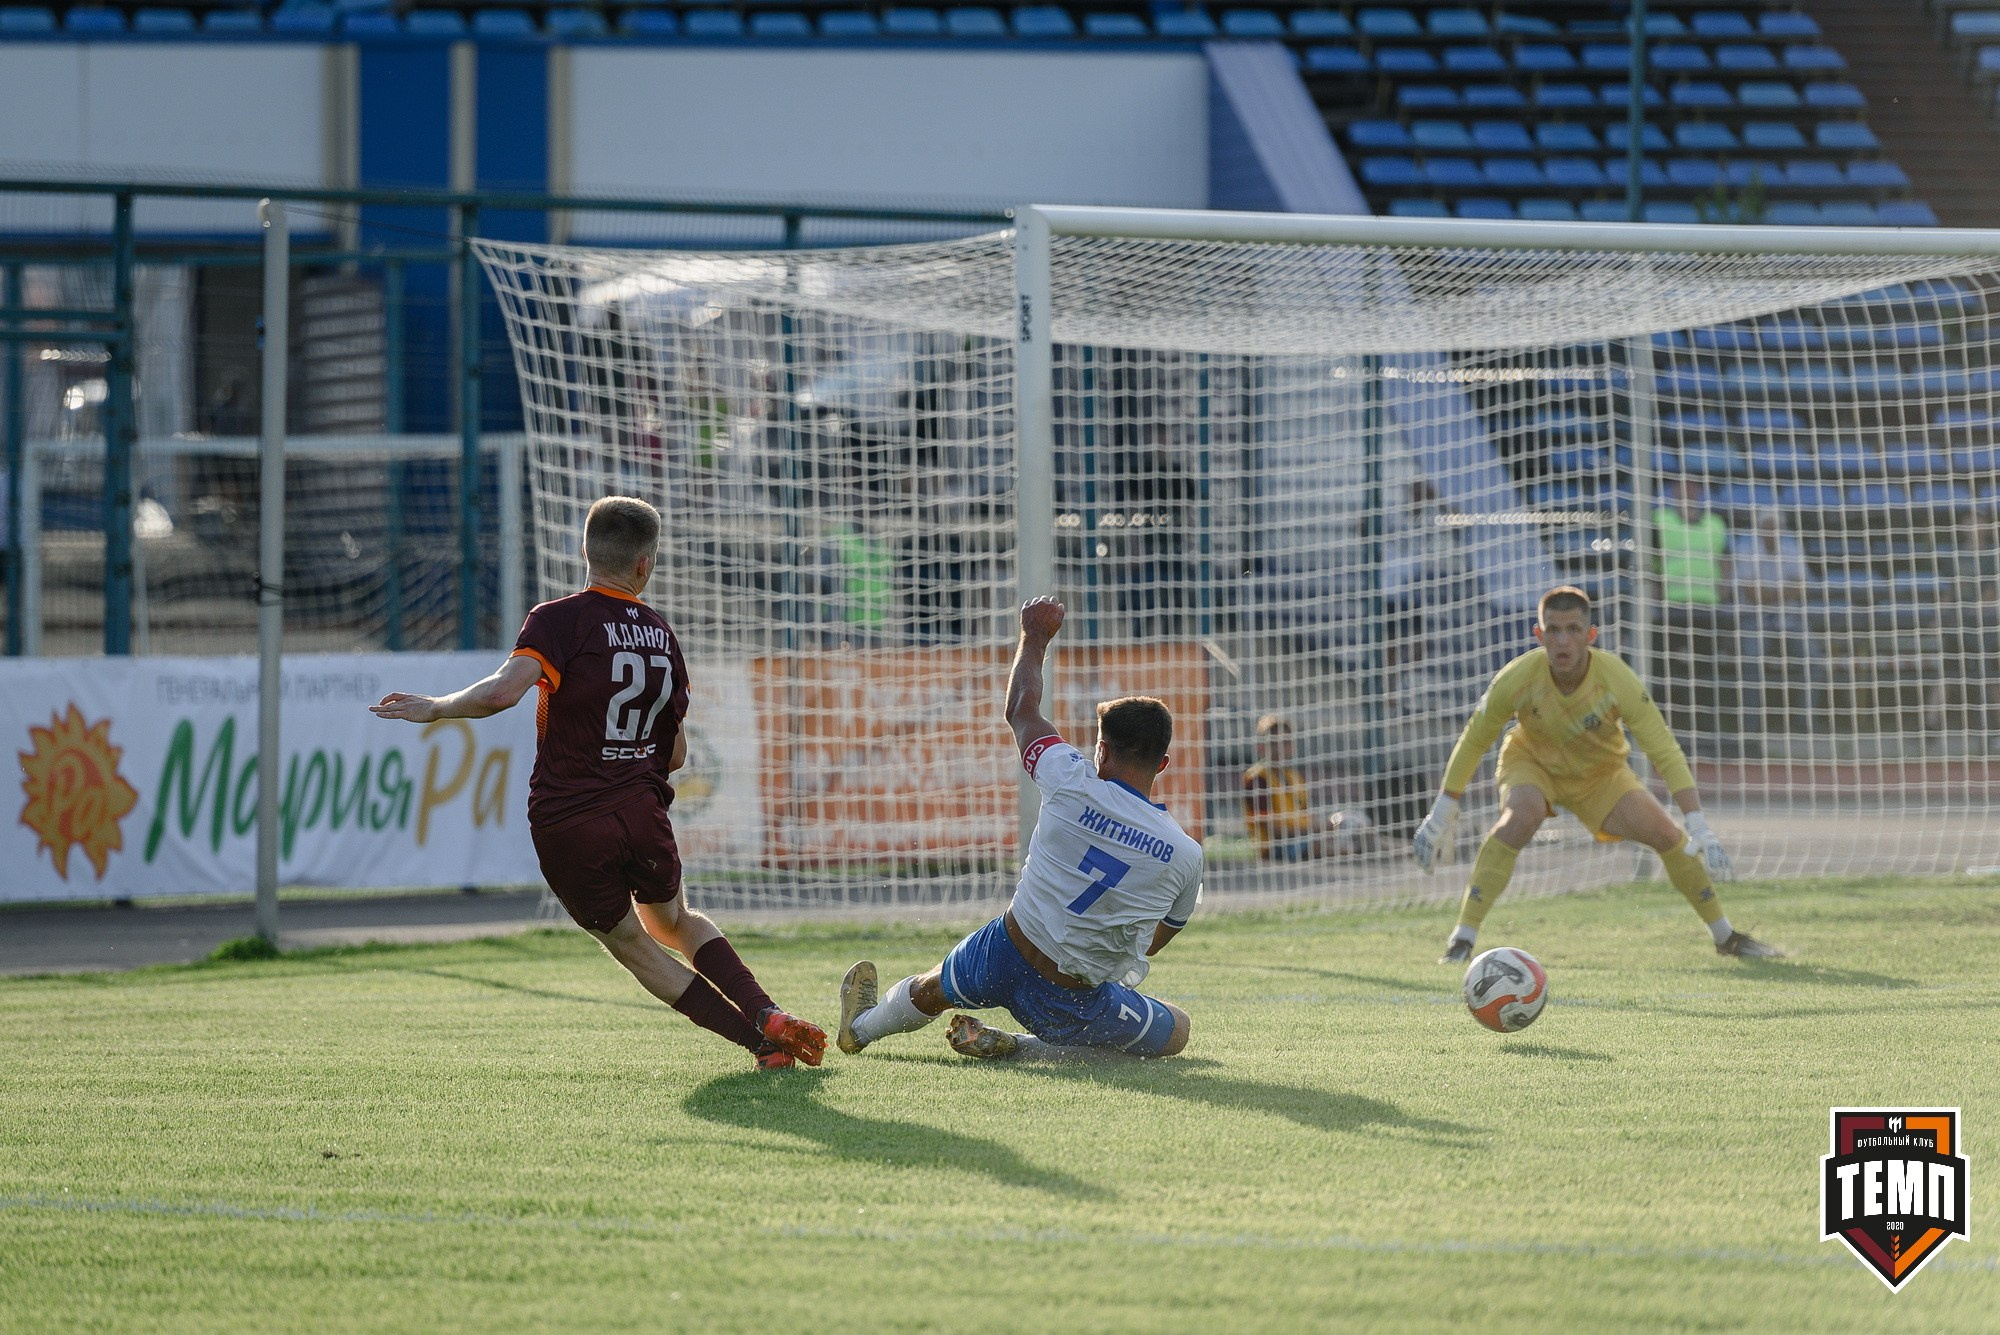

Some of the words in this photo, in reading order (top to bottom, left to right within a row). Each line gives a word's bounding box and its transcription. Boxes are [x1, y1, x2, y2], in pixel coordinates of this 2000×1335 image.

[605, 651, 673, 741] 27
[1078, 805, 1175, 864] ЖИТНИКОВ
[1066, 844, 1131, 915] 7
[1118, 1003, 1142, 1023] 7
